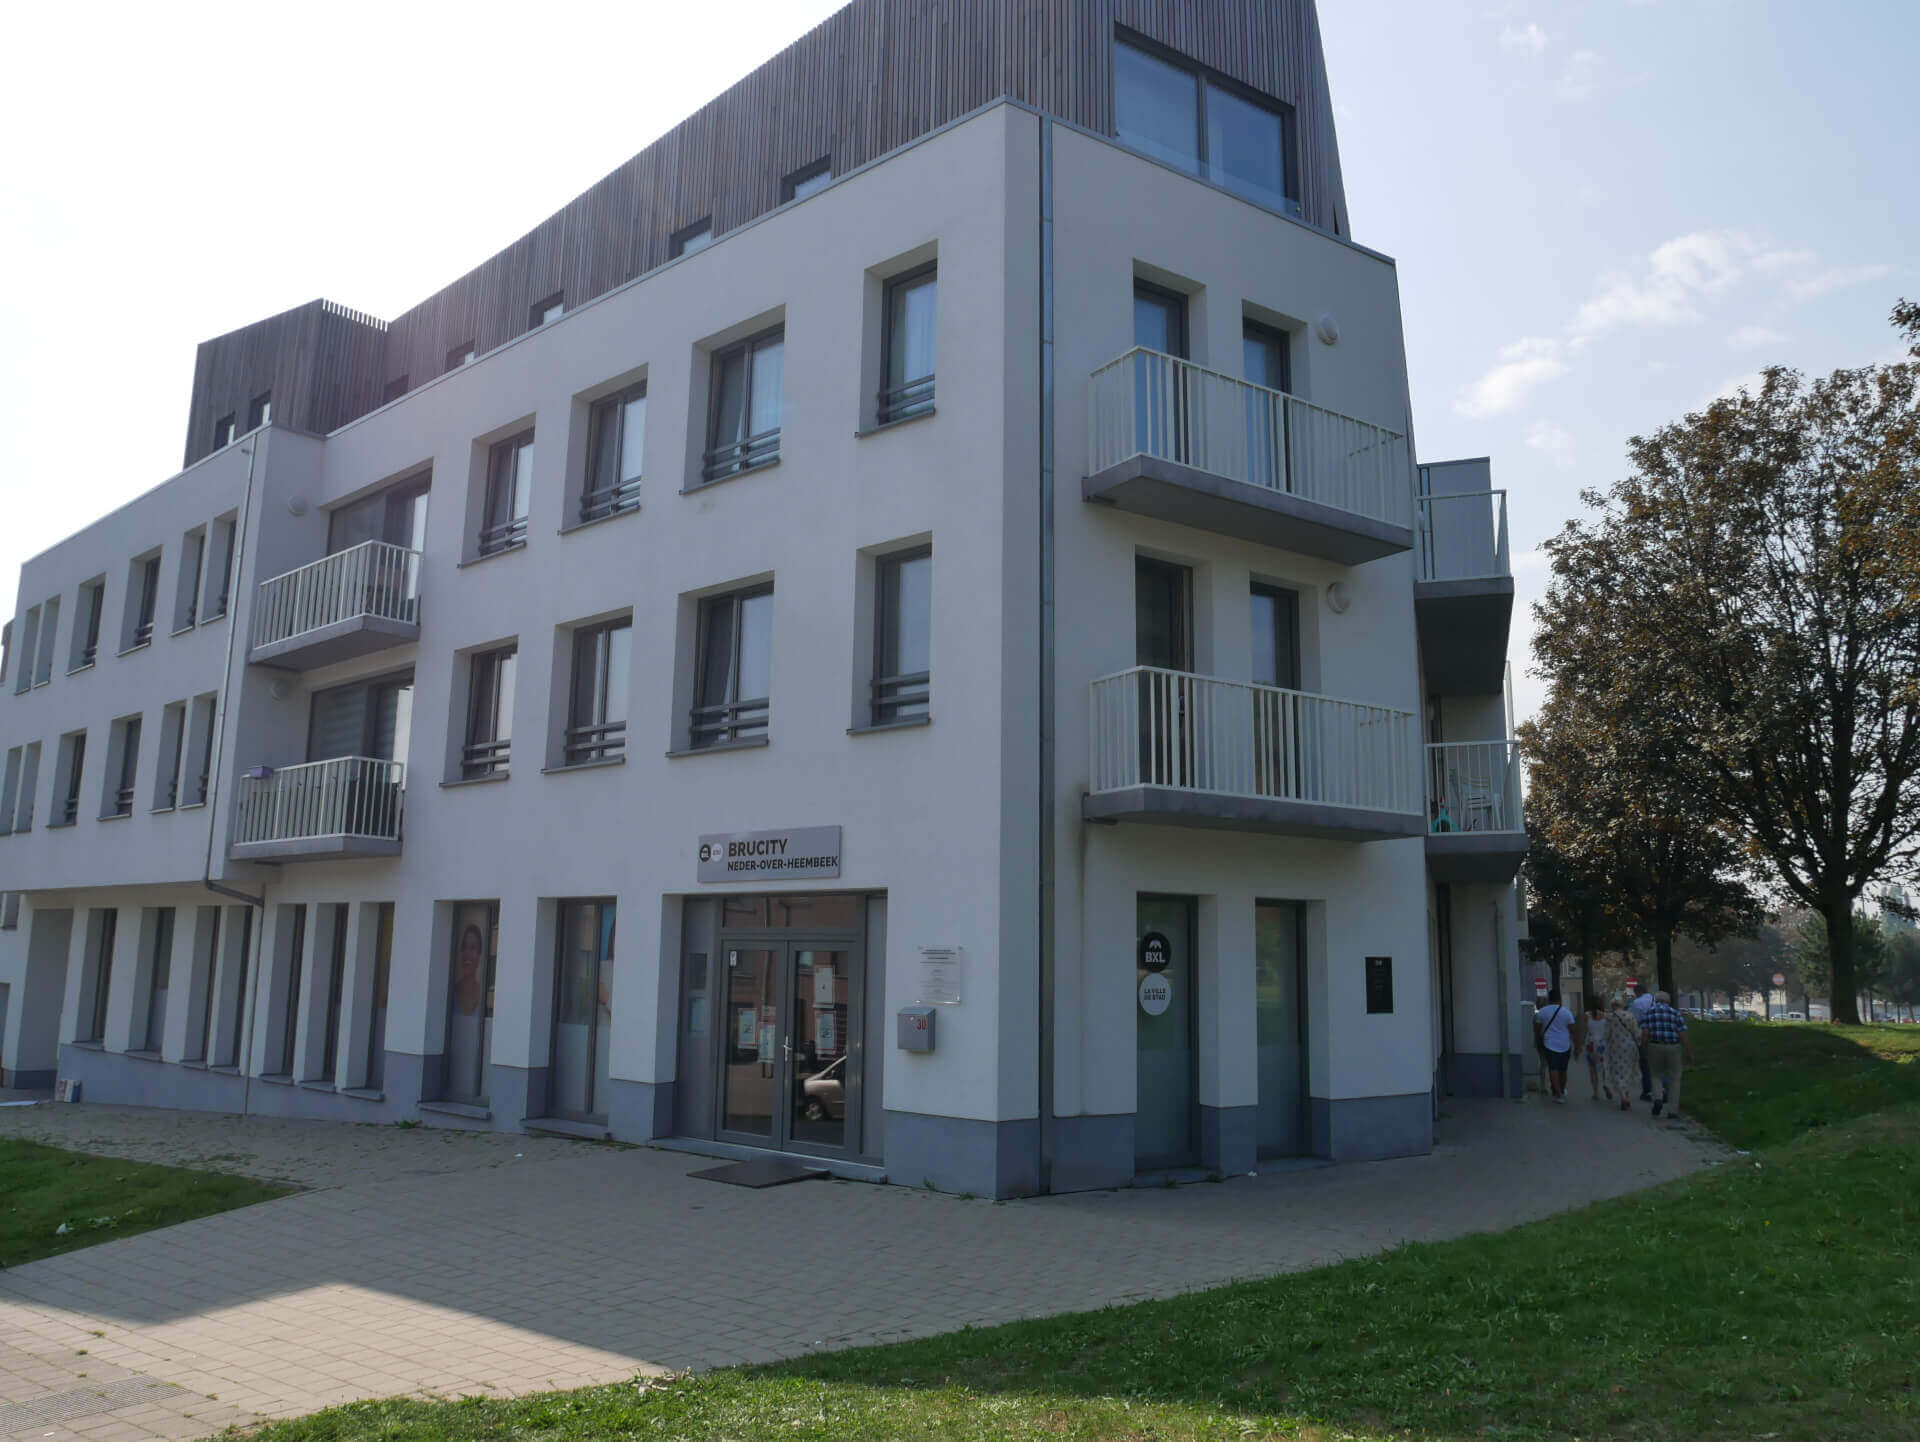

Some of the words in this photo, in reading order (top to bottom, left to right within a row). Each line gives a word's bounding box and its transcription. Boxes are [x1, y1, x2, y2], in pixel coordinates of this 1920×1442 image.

[728, 838, 788, 857] BRUCITY
[727, 855, 838, 871] NEDER-OVER-HEEMBEEK
[1145, 951, 1166, 963] BXL
